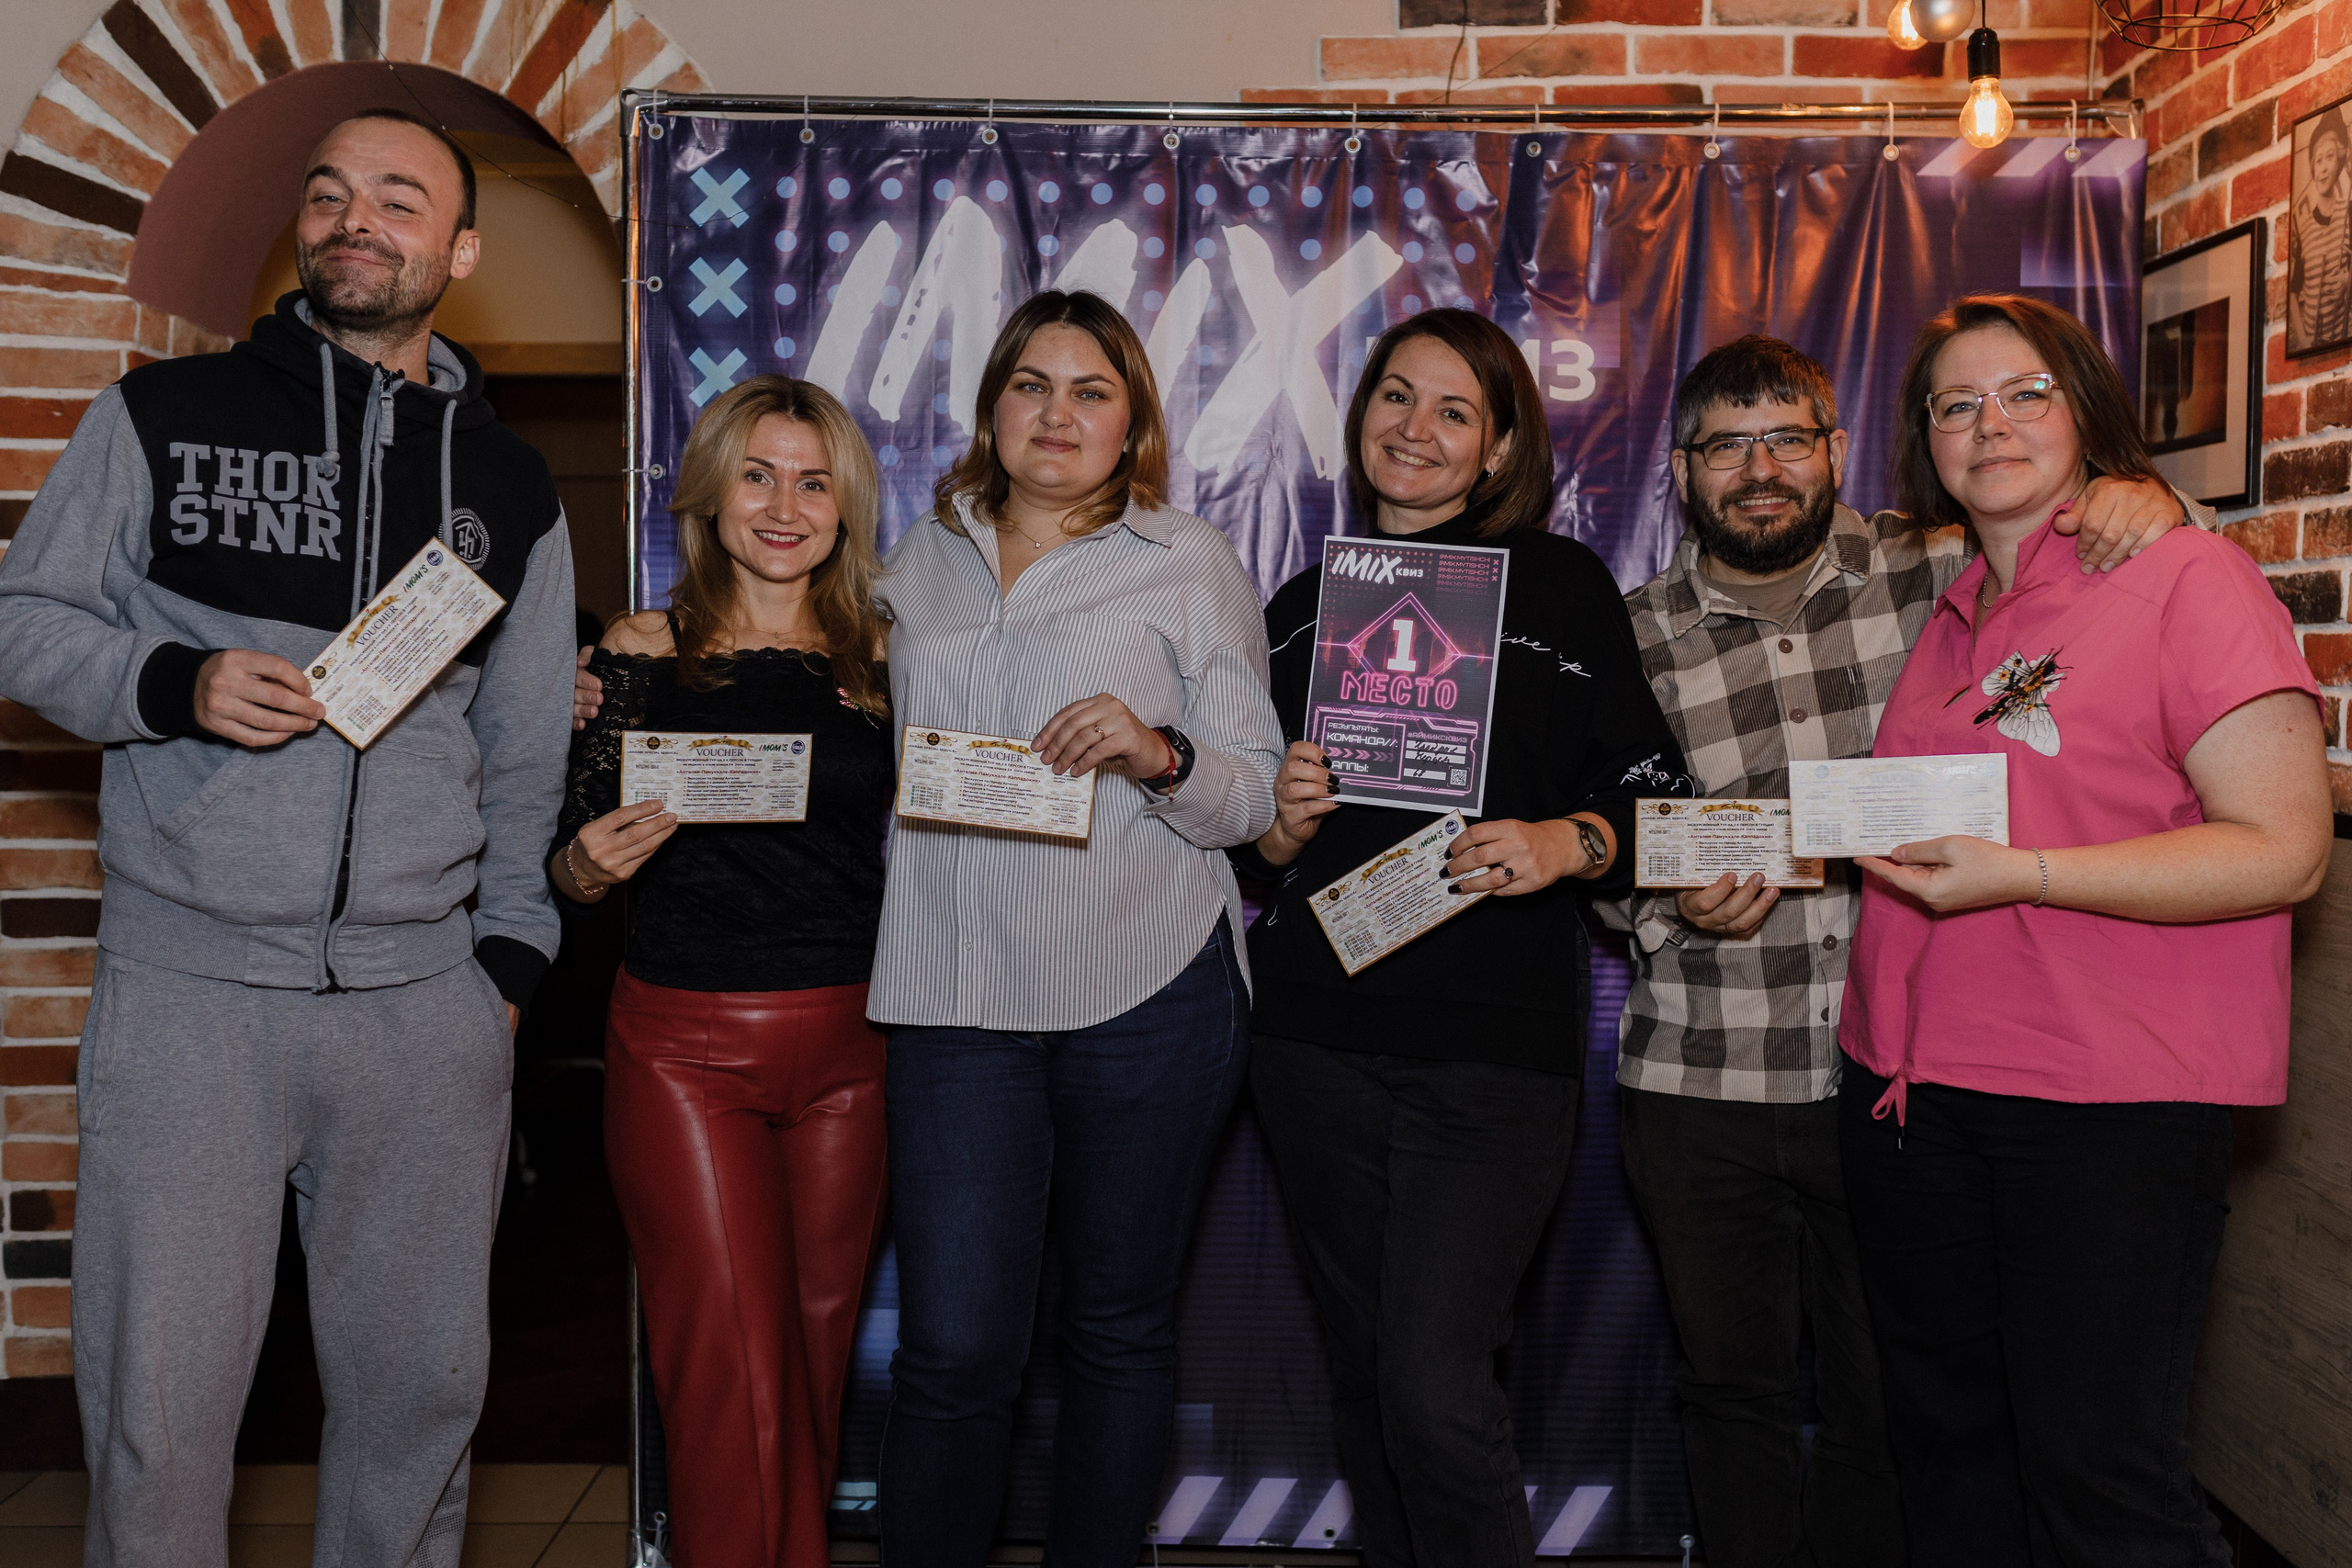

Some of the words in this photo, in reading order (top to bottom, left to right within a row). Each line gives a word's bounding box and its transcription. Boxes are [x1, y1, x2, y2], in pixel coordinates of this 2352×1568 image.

[169, 442, 341, 510] THOR
[169, 493, 341, 562] STNR
[1396, 568, 1424, 578] КВИЗ
[356, 603, 400, 648] VOUCHER
[1386, 618, 1417, 672] 1
[1340, 671, 1458, 710] МЕСТО
[695, 748, 744, 757] VOUCHER
[974, 749, 1024, 763] VOUCHER
[1330, 761, 1369, 773] АЛЛЫ:
[1706, 813, 1755, 821] VOUCHER
[1367, 855, 1408, 886] VOUCHER
